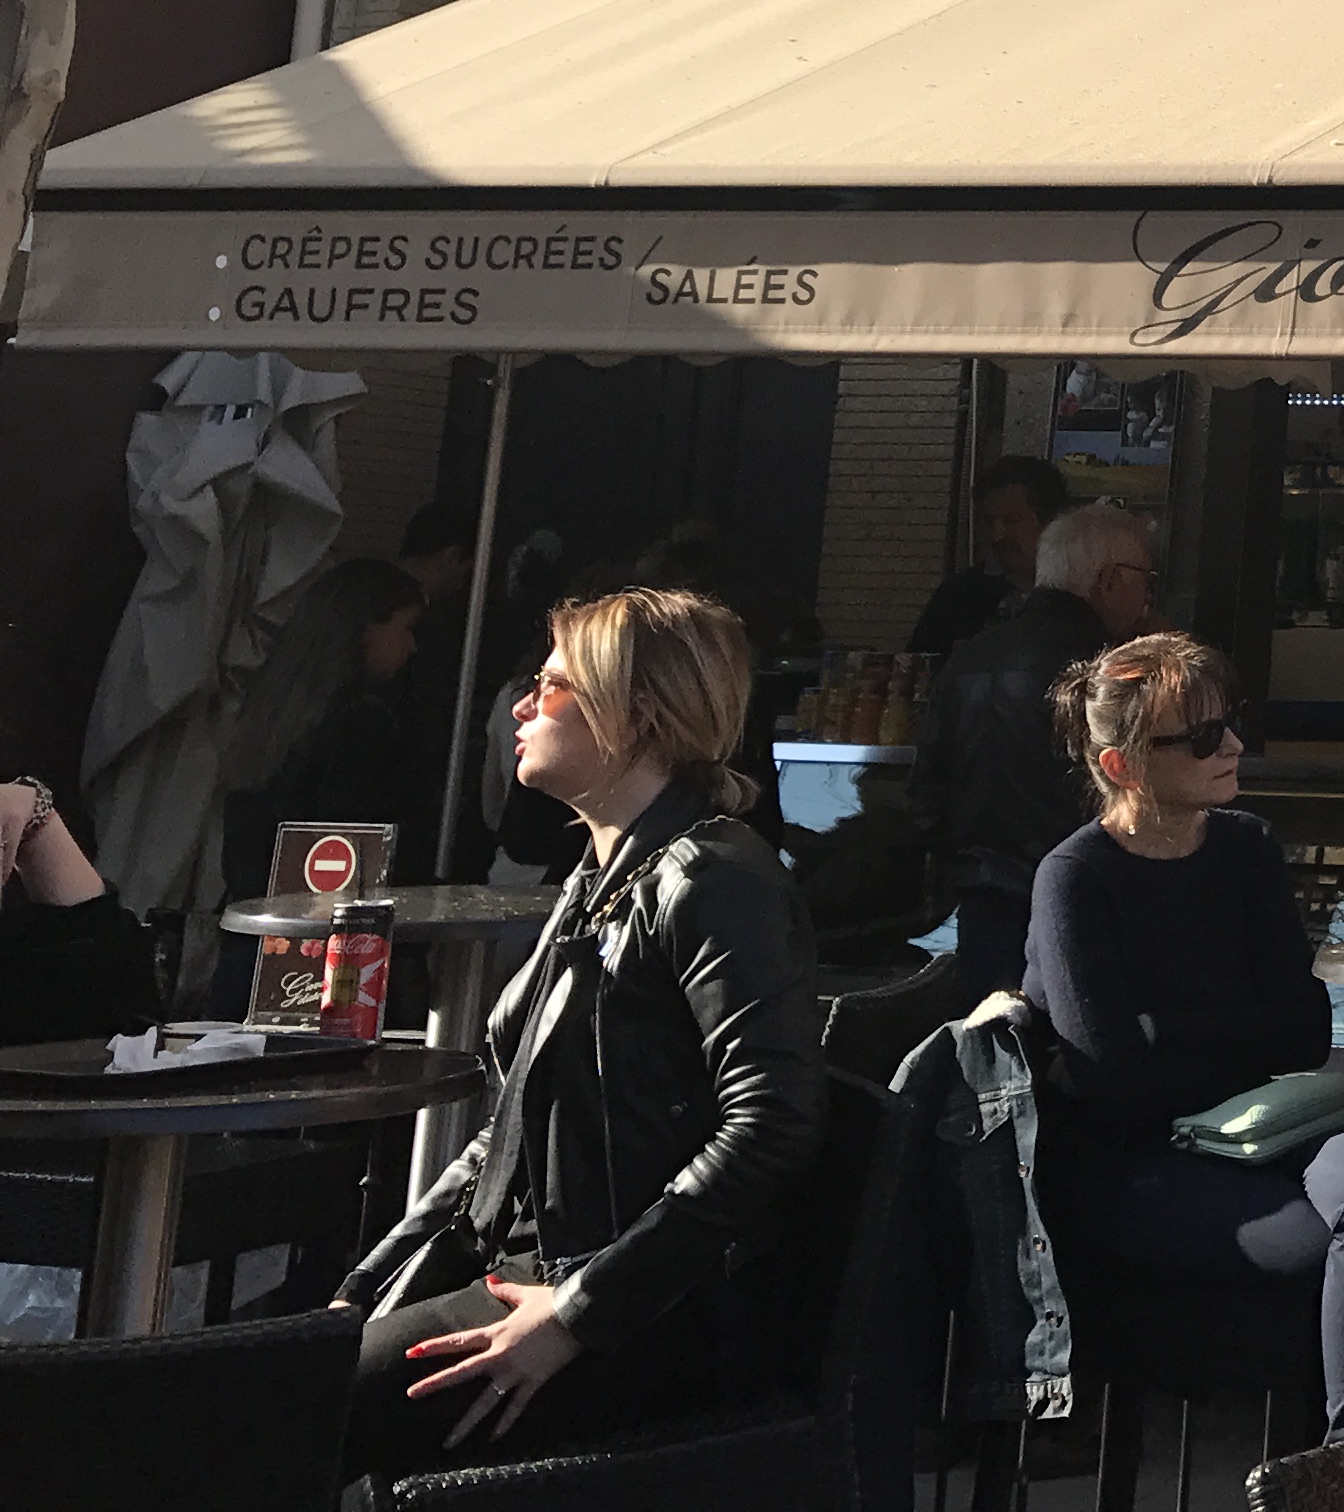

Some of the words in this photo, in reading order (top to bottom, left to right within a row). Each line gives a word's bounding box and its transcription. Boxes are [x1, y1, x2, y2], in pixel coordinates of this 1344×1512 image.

[241, 225, 409, 271] CRÊPES
[645, 255, 820, 306] SALÉES
[235, 285, 480, 325] GAUFRES
